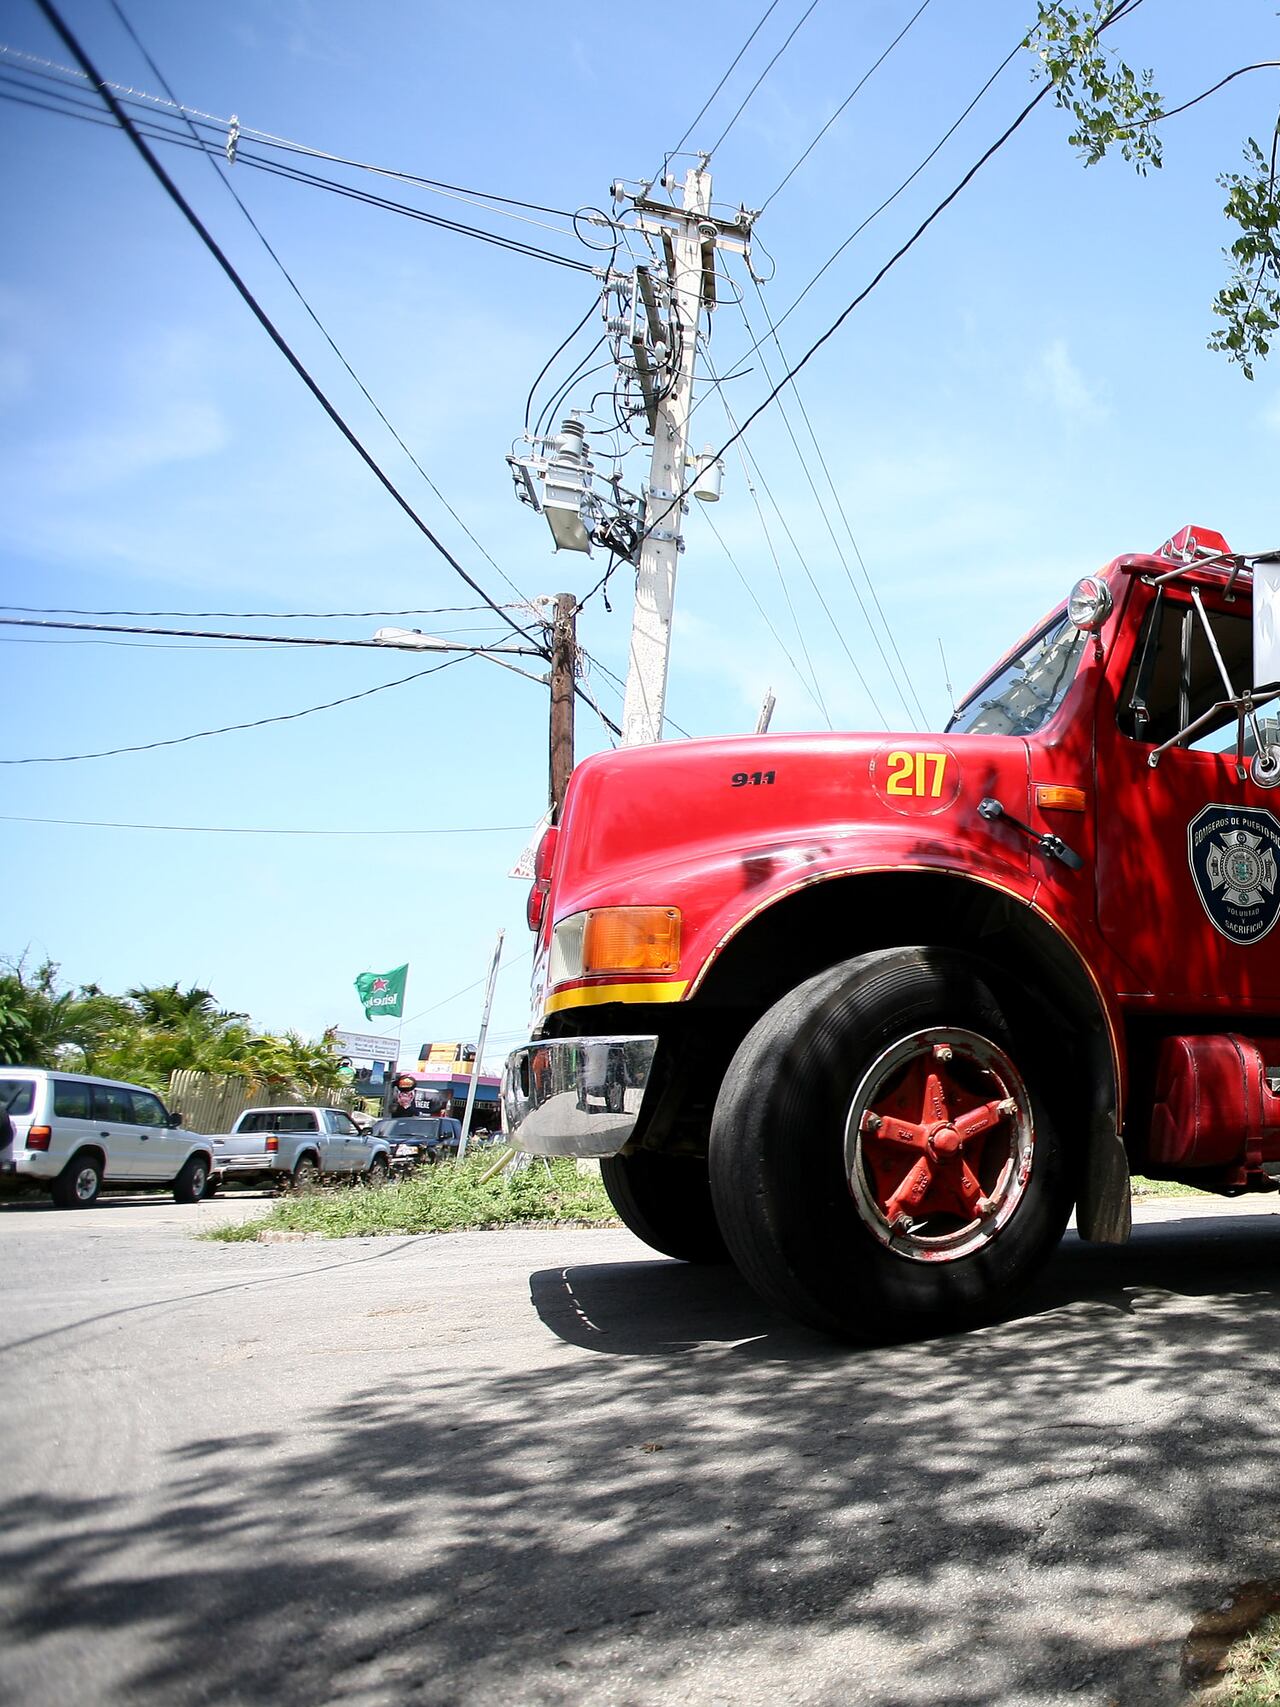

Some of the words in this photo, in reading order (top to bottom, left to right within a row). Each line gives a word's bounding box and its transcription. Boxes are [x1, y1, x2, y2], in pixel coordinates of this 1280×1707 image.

[887, 751, 947, 797] 217
[1195, 818, 1229, 846] BOMBEROS
[1231, 817, 1239, 825] DE
[1242, 818, 1270, 838] PUERTO
[1226, 906, 1260, 917] VOLUNTAD
[1225, 919, 1264, 935] SACRIFICIO
